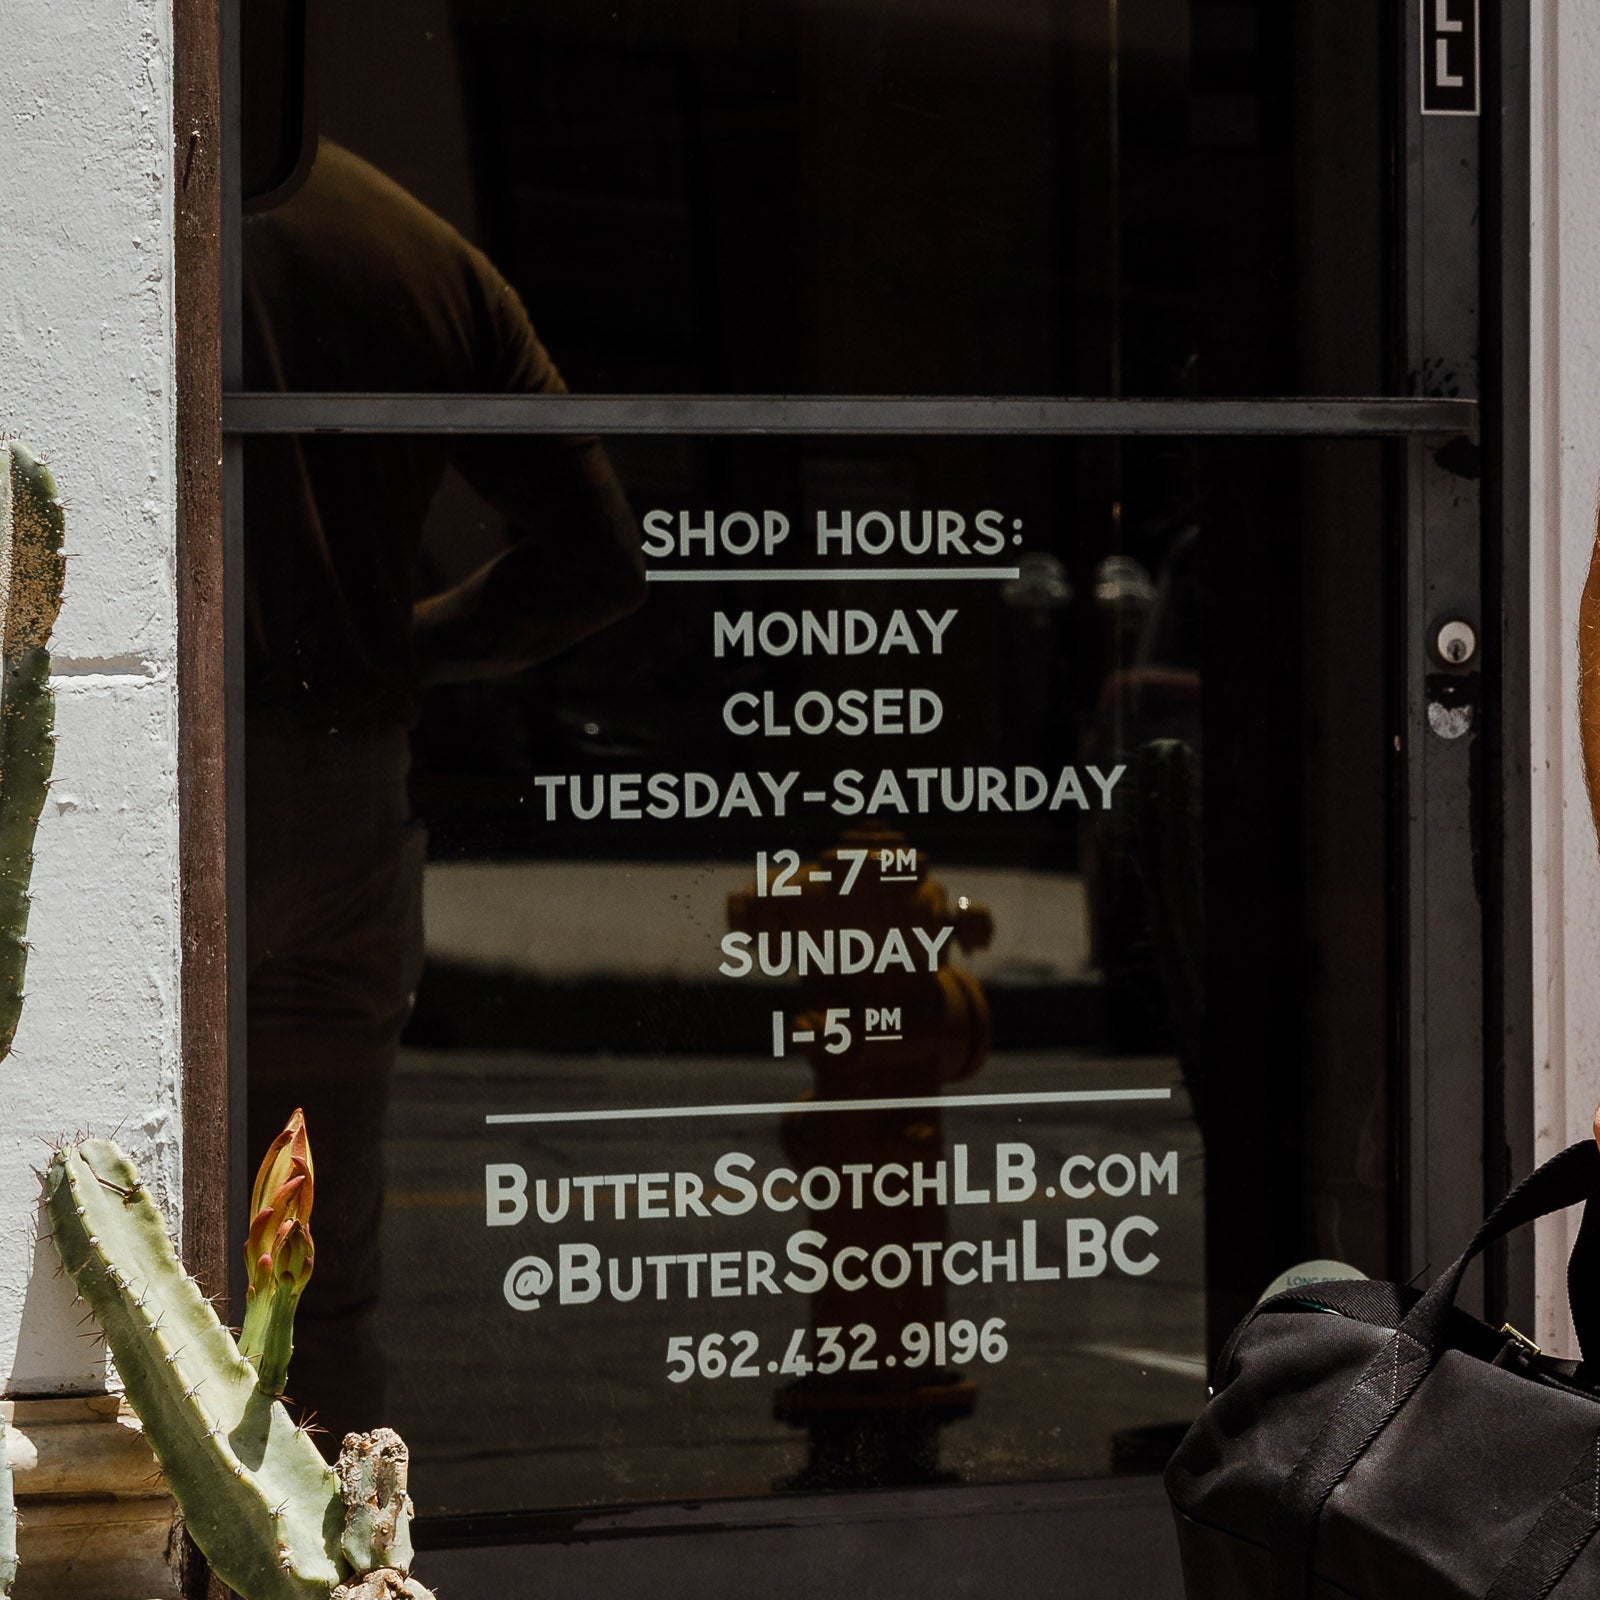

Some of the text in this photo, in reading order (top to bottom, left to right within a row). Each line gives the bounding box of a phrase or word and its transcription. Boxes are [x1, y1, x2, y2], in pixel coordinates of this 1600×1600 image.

[641, 510, 1023, 557] SHOP HOURS:
[713, 609, 958, 657] MONDAY
[722, 689, 944, 737] CLOSED
[534, 764, 1127, 821] TUESDAY-SATURDAY
[756, 848, 917, 897] 12-7 PM
[718, 926, 954, 978] SUNDAY
[772, 1007, 902, 1057] 1-5 PM
[665, 1317, 1009, 1383] 562.432.9196
